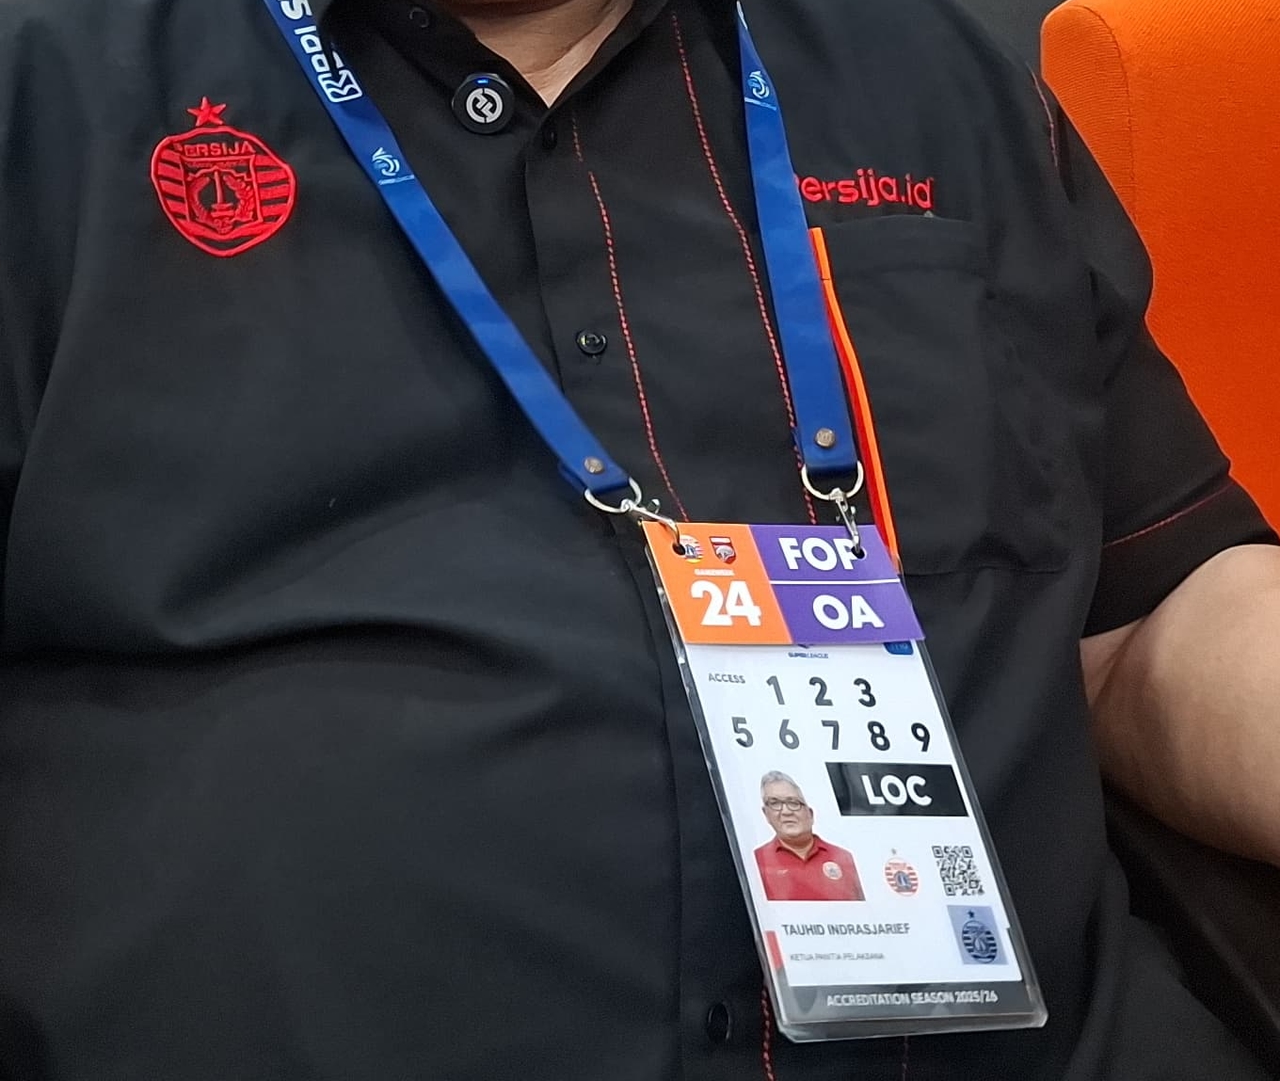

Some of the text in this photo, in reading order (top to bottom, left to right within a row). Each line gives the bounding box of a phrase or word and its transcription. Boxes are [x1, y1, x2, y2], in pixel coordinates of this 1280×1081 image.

[794, 168, 933, 209] ersija.id
[778, 537, 857, 571] FOP
[690, 580, 762, 626] 24
[812, 594, 885, 630] OA
[708, 673, 876, 708] ACCESS 1 2 3
[731, 717, 931, 752] 5 6 7 8 9
[861, 775, 932, 806] LOC
[781, 922, 910, 936] TAUHID INDRASJARIEF
[826, 989, 999, 1007] ACCREDITATION SEASON 2025/26
